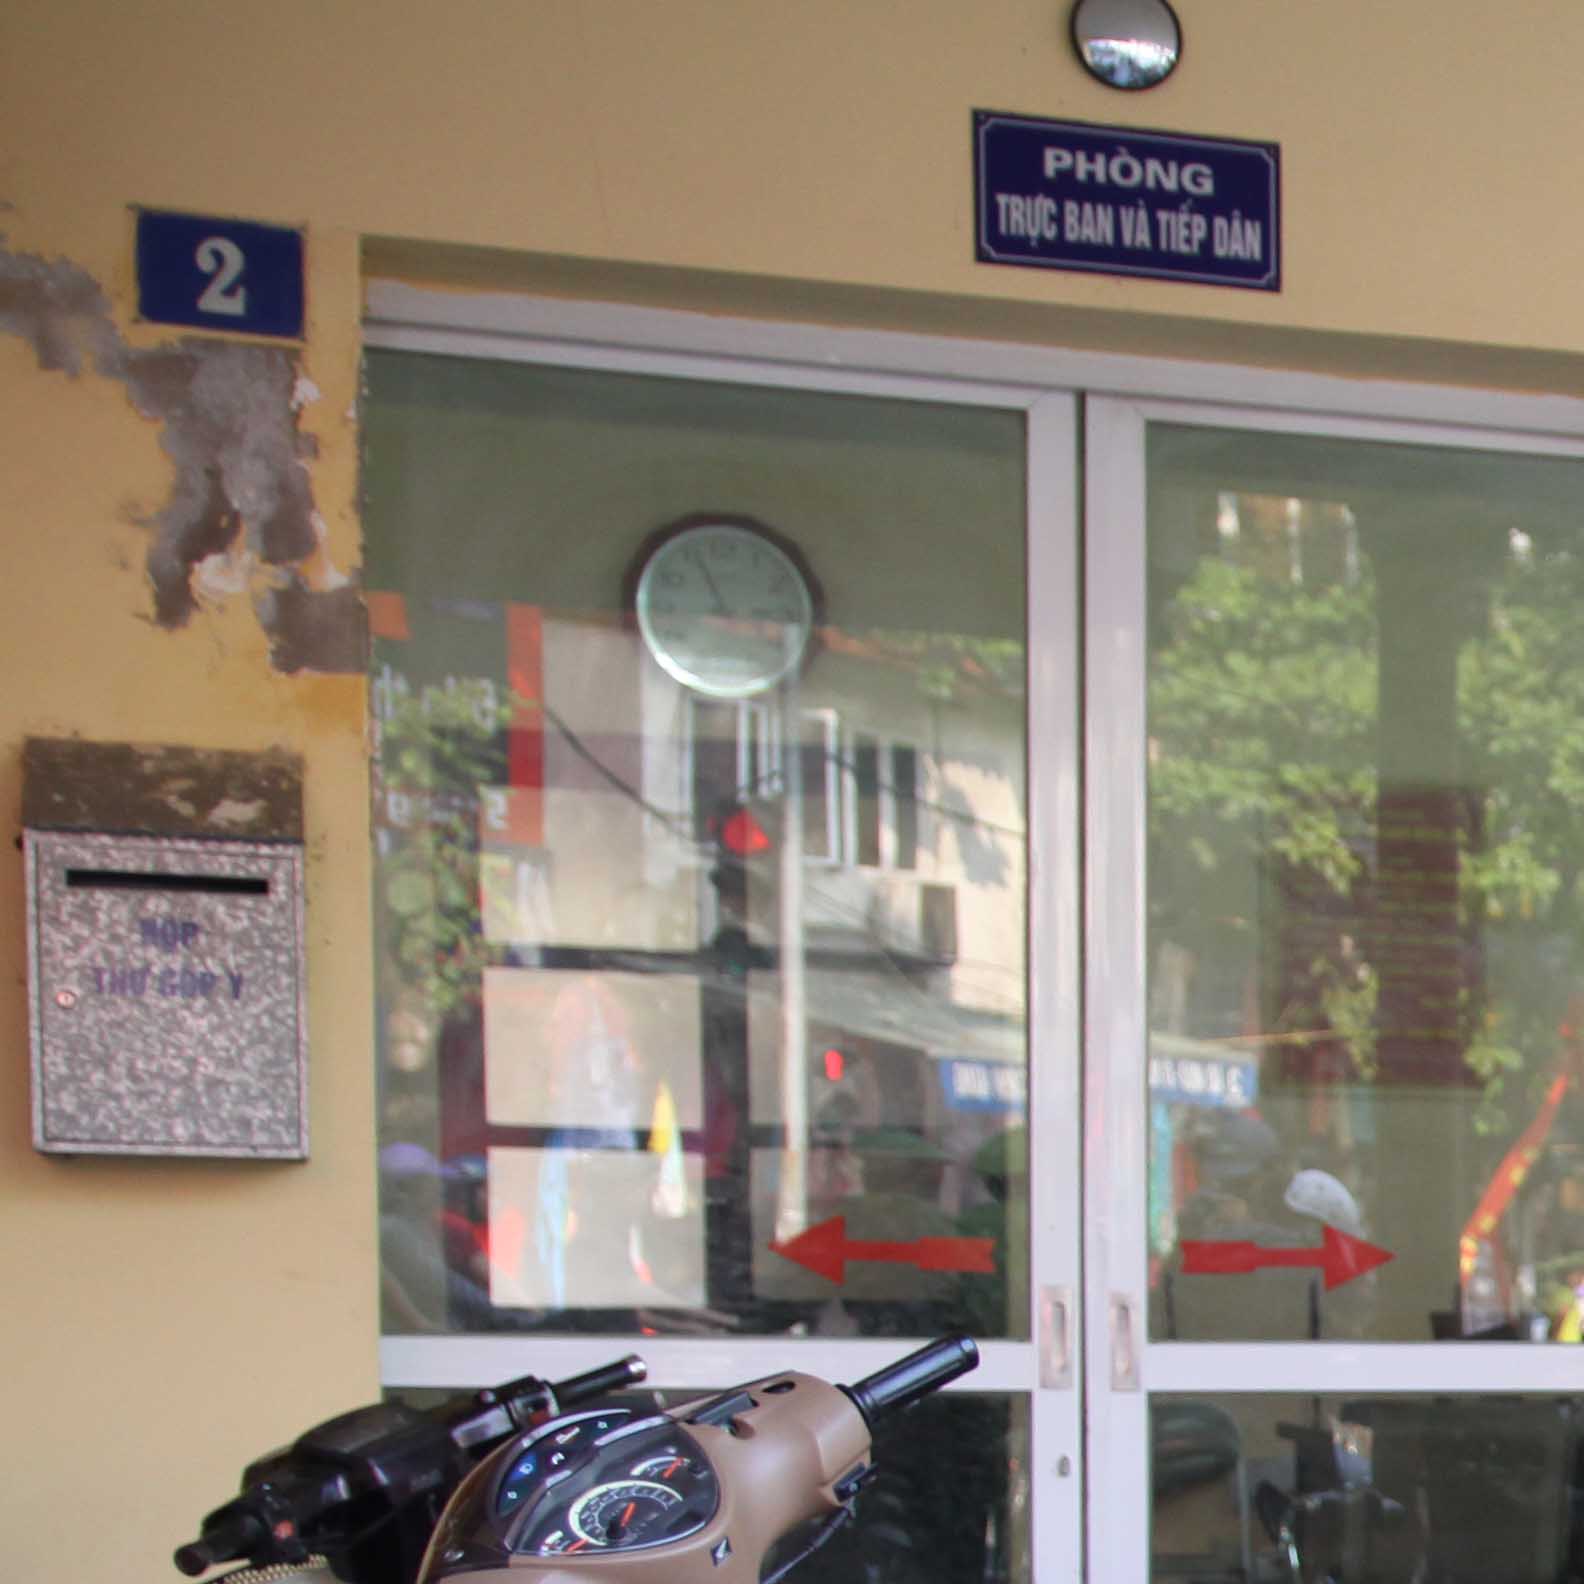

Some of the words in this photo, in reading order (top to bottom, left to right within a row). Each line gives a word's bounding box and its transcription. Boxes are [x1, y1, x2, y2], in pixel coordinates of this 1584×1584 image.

[1043, 146, 1215, 196] PHÒNG
[996, 193, 1057, 249] TRỰC
[1063, 200, 1114, 247] BAN
[1119, 200, 1150, 249] VÀ
[1157, 199, 1206, 254] TIẾP
[1213, 210, 1263, 262] DÂN
[195, 236, 245, 316] 2
